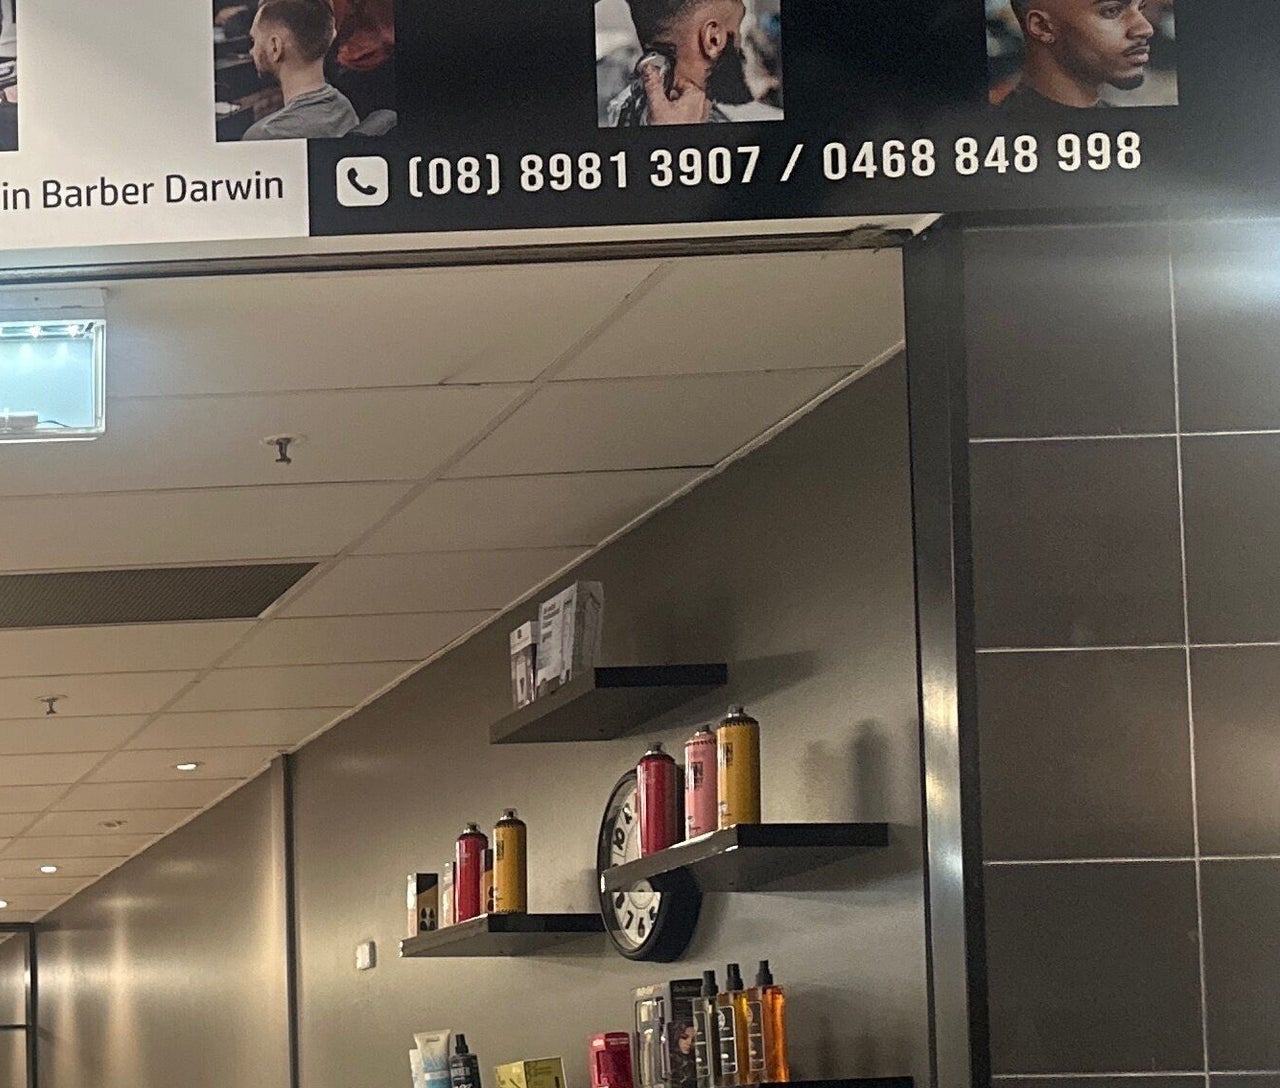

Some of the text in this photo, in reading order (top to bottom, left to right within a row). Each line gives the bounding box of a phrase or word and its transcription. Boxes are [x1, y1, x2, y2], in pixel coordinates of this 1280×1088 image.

[41, 174, 155, 211] Barber
[165, 168, 286, 205] Darwin
[407, 130, 1143, 199] (08) 8981 3907 / 0468 848 998
